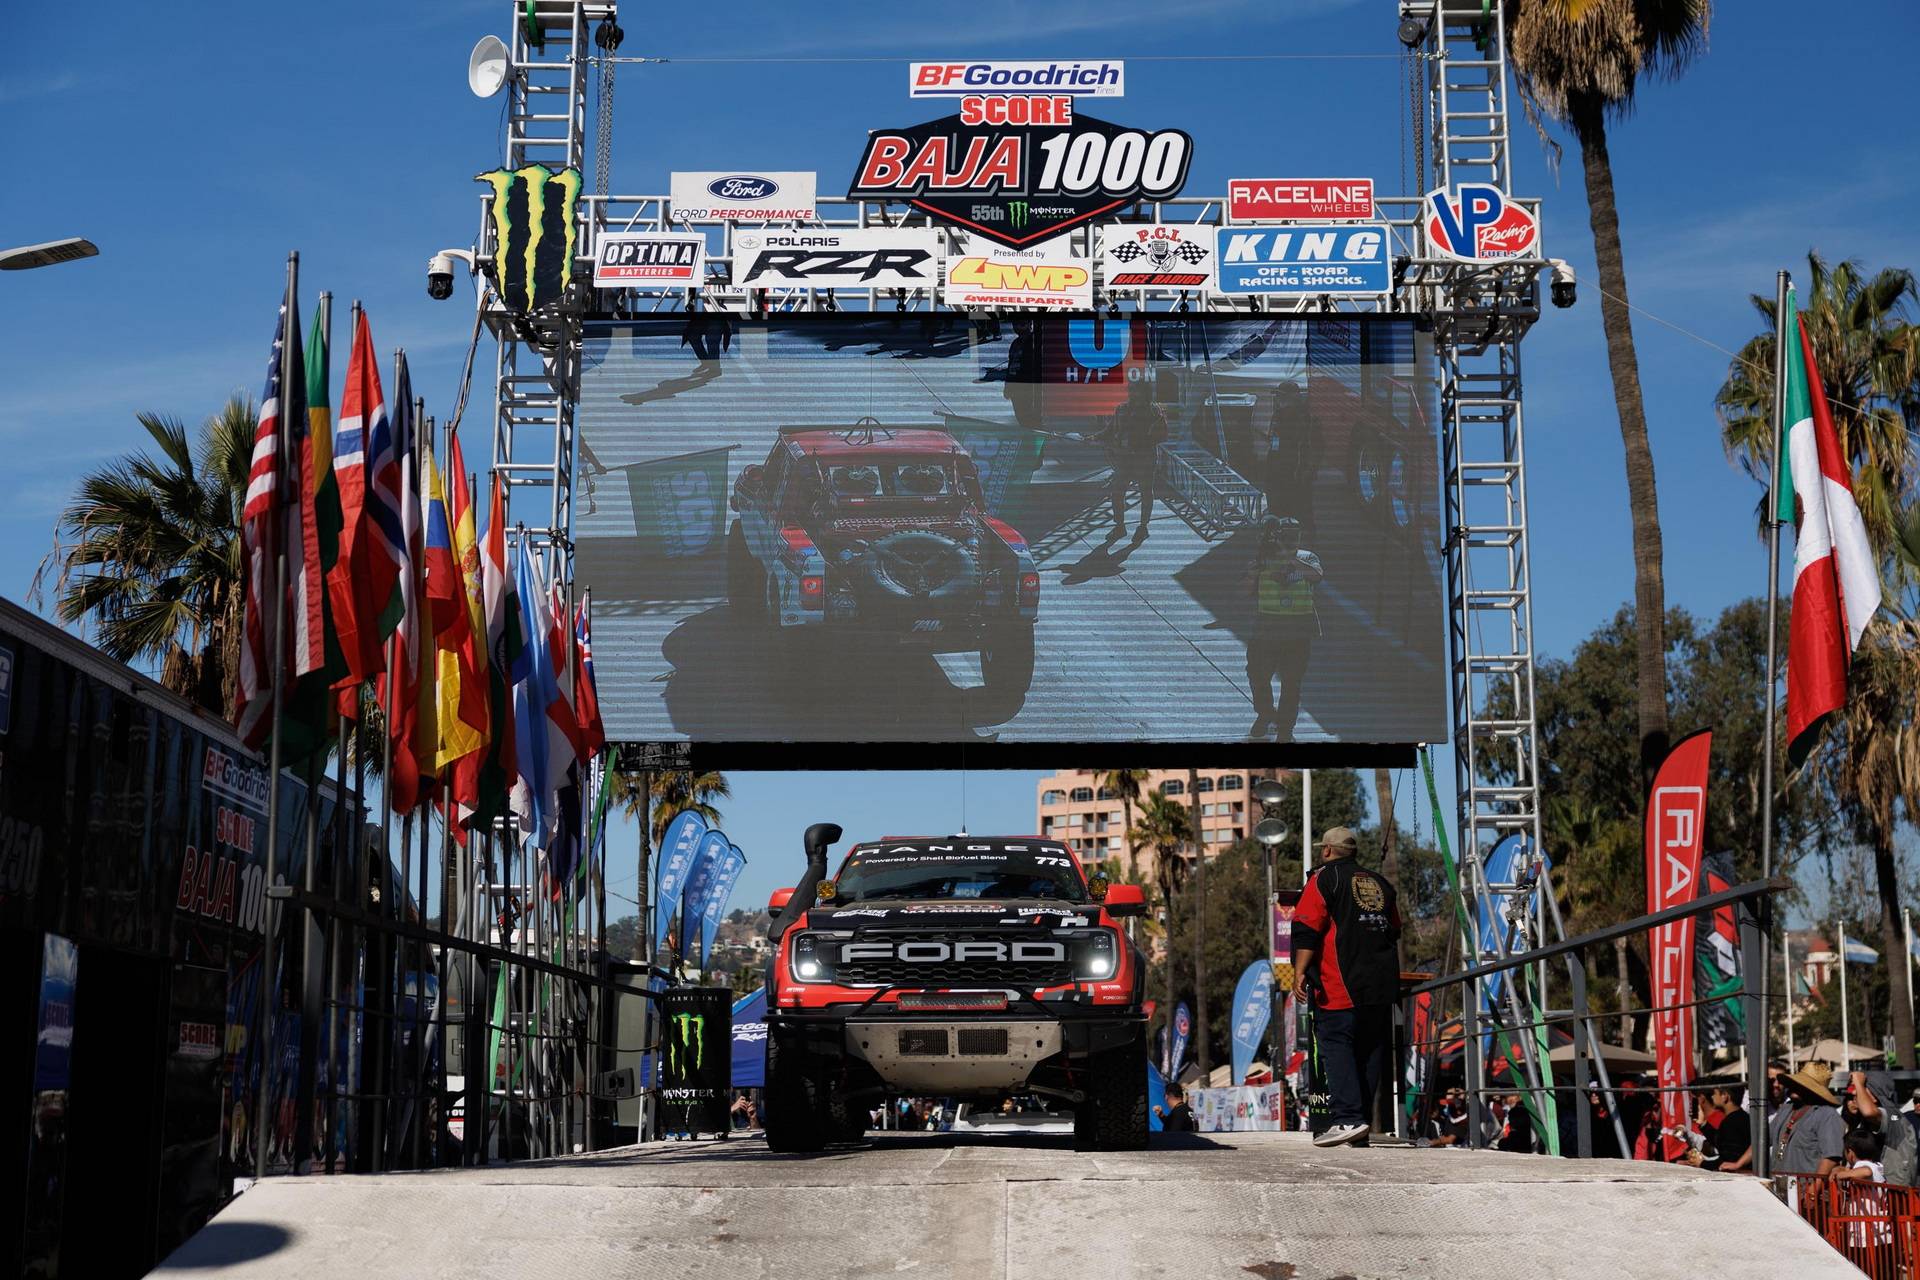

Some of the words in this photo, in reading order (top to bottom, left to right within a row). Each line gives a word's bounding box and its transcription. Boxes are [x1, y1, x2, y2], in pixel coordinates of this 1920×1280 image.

[915, 64, 1120, 86] BFGoodrich
[961, 96, 1072, 125] SCORE
[857, 135, 1021, 189] BAJA
[1038, 131, 1187, 192] 1000
[721, 179, 765, 198] Ford
[1233, 186, 1370, 204] RACELINE
[673, 209, 708, 219] FORD
[710, 209, 812, 219] PERFORMANCE
[971, 204, 1004, 221] 55th
[1029, 206, 1076, 216] MONSTER
[1311, 203, 1370, 213] WHEELS
[1432, 187, 1504, 259] VP
[766, 237, 840, 247] POLARIS
[1137, 227, 1182, 243] P.C.I.
[1480, 222, 1535, 247] Racing
[605, 242, 692, 265] OPTIMA
[993, 249, 1033, 258] Presented
[1034, 250, 1046, 259] by
[1224, 232, 1382, 262] KING
[1481, 250, 1517, 258] FUELS
[619, 267, 674, 277] BATTERIES
[742, 249, 932, 283] RZR
[950, 257, 1088, 291] 4WP
[1114, 274, 1150, 285] RACE
[1152, 274, 1204, 285] RADIOS
[1239, 277, 1299, 286] RACING
[216, 805, 255, 855] SCORE
[662, 822, 697, 892] KING
[865, 856, 906, 864] Powered
[1034, 856, 1072, 868] 773
[176, 844, 236, 924] BAJA
[841, 942, 1065, 964] FORD
[180, 1022, 216, 1045] SCORE
[662, 1087, 715, 1099] MONSTER
